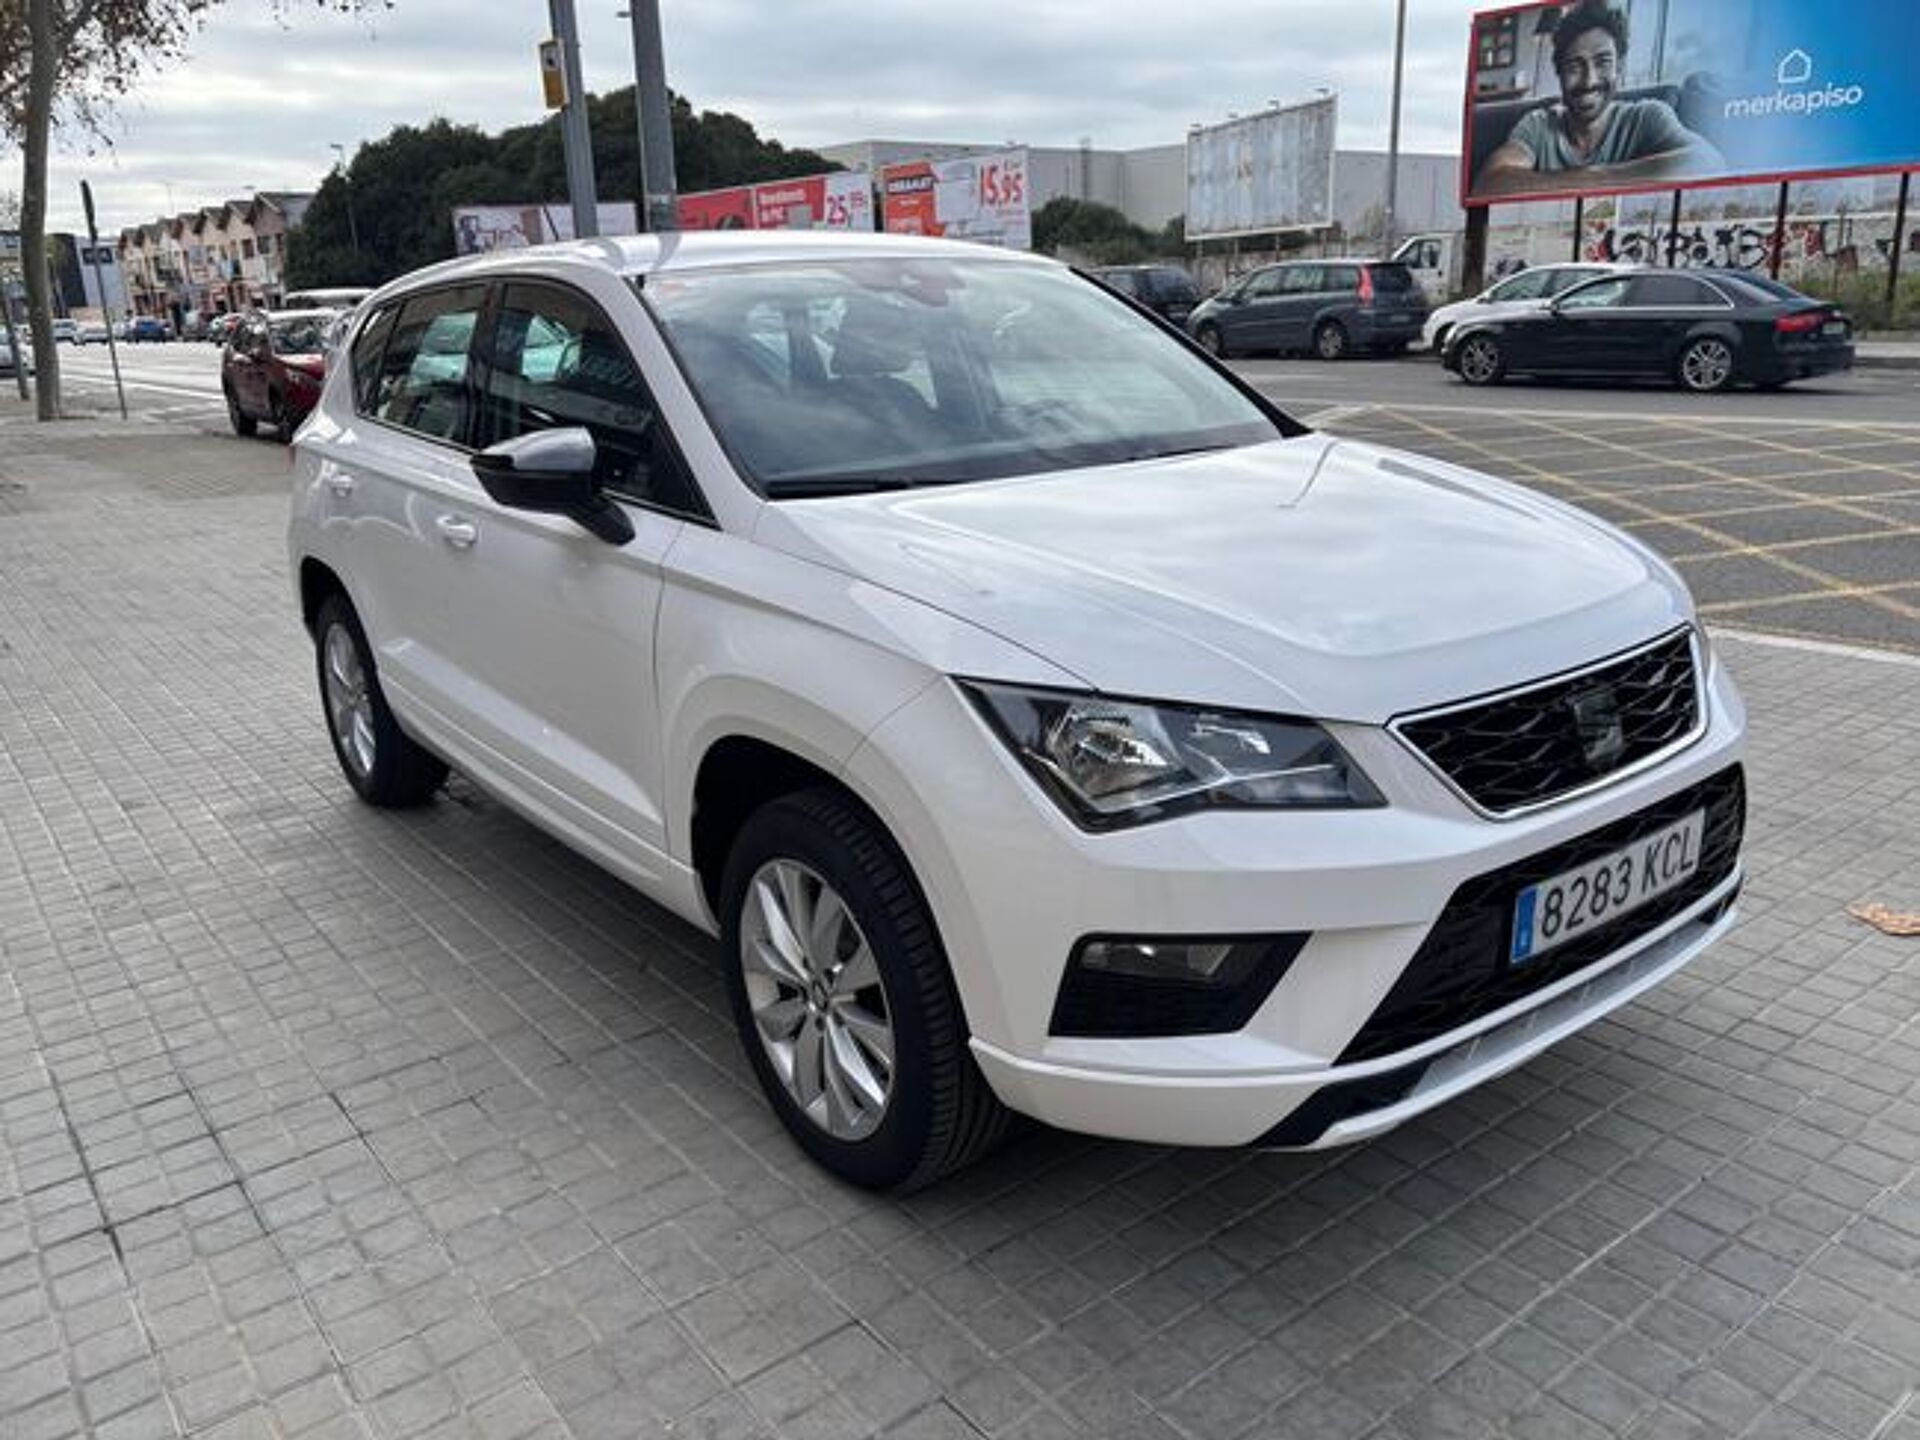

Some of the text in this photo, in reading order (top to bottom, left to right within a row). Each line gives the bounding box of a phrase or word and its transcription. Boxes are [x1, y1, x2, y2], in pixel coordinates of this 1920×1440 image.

[1724, 82, 1863, 119] merkapiso
[1541, 826, 1694, 938] 8283 KCL
